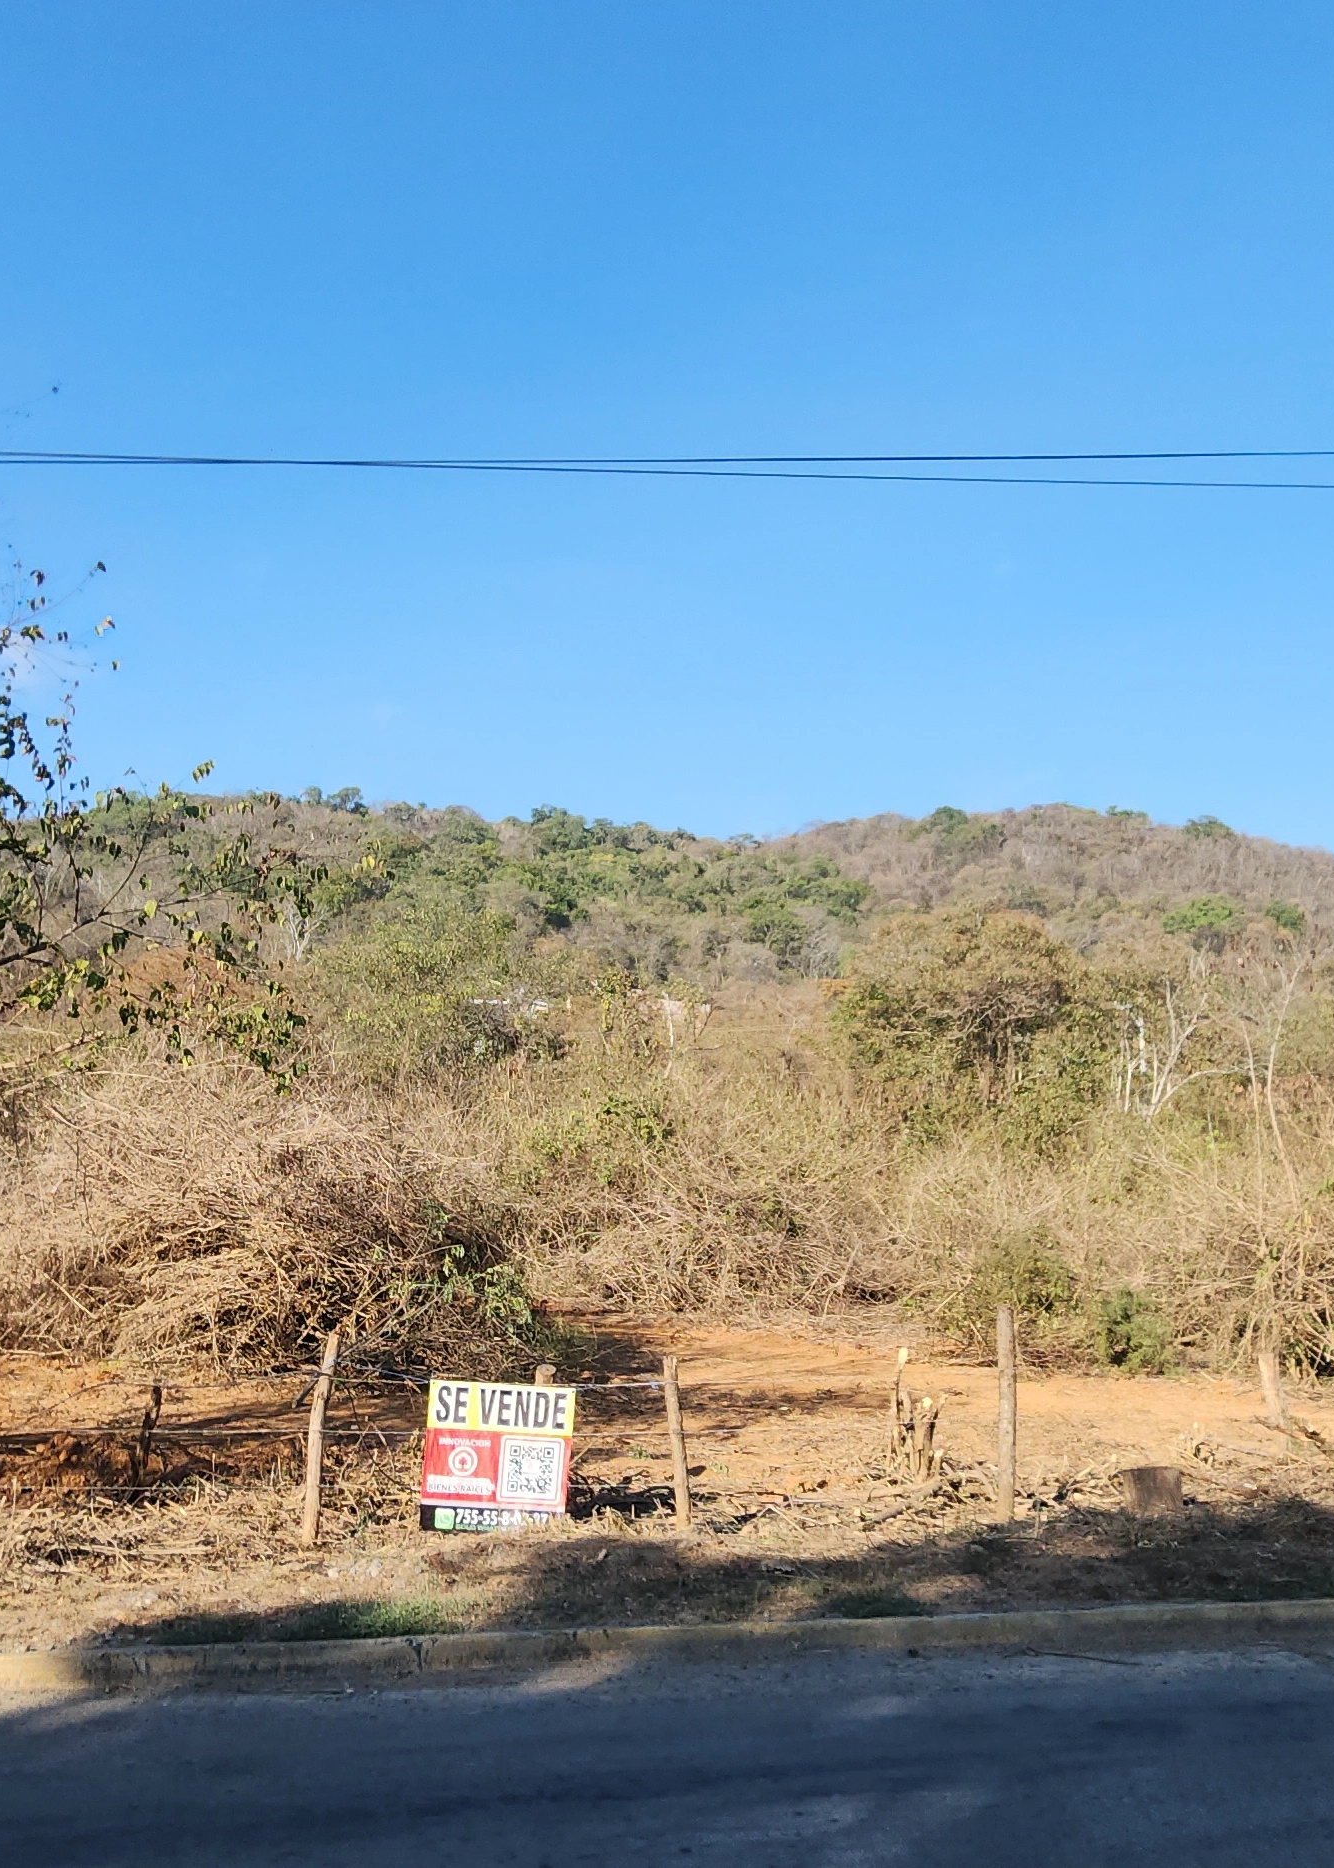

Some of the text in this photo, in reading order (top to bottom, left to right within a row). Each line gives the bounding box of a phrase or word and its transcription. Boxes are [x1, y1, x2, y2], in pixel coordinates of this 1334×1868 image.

[435, 1385, 568, 1430] SE VENDE
[438, 1437, 491, 1448] INNOVACION
[428, 1483, 458, 1492] BIENES
